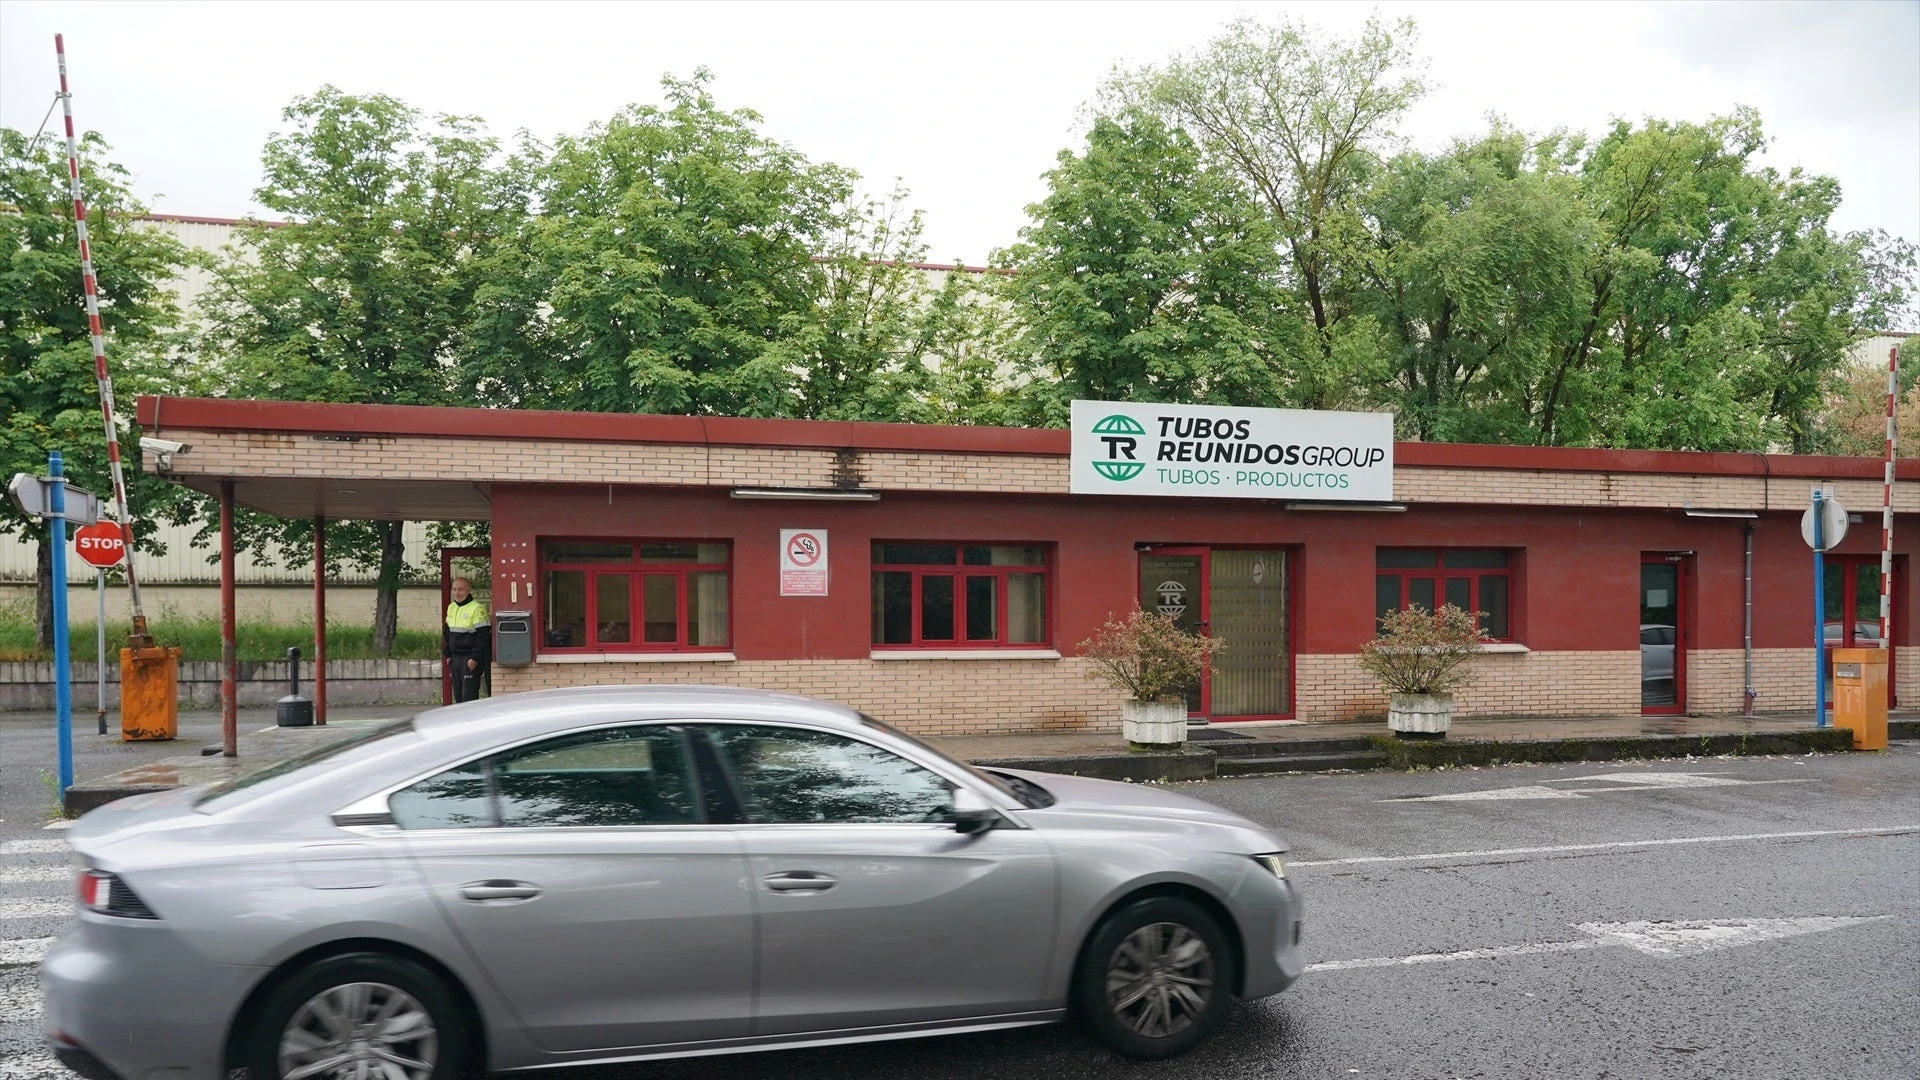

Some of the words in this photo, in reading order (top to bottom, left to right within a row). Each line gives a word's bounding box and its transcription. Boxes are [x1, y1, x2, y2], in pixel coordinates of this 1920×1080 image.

[1157, 416, 1251, 440] TUBOS
[1100, 436, 1137, 460] TR
[1156, 469, 1221, 485] TUBOS
[1236, 471, 1349, 489] PRODUCTOS
[80, 537, 123, 550] STOP
[1160, 592, 1182, 605] TR
